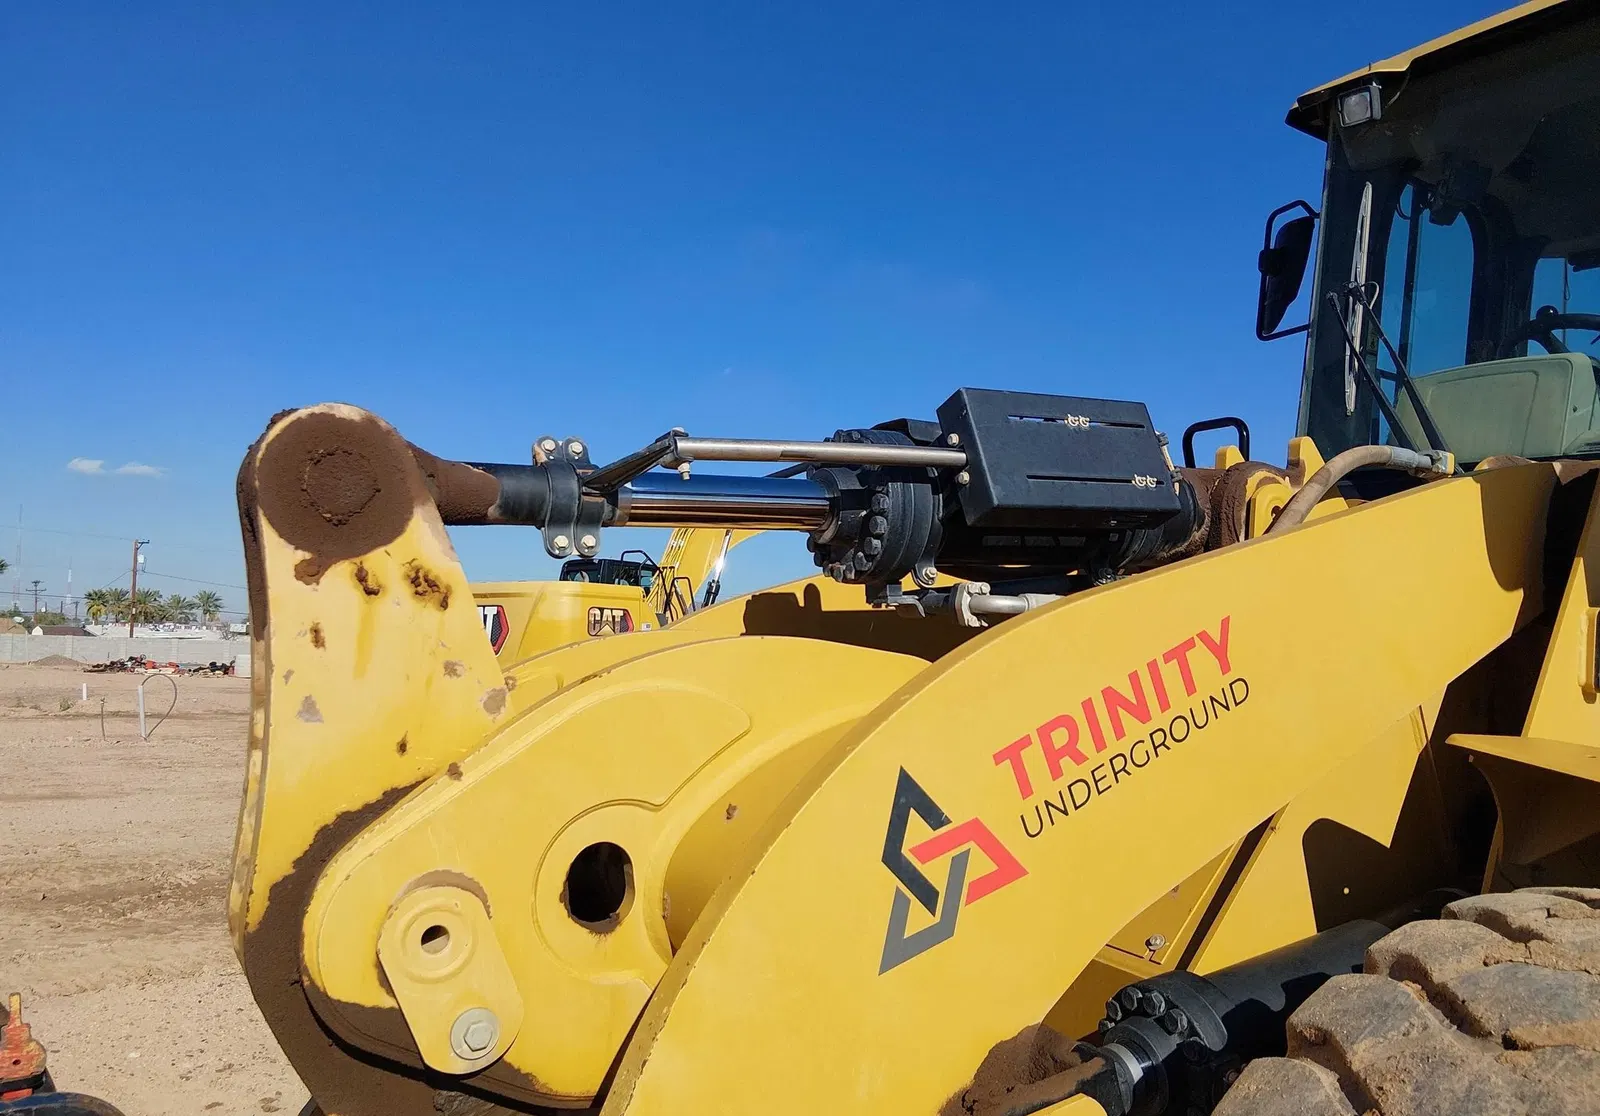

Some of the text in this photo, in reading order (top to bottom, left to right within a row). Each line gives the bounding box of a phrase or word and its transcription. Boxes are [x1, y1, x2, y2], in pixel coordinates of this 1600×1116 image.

[589, 608, 624, 635] CAT
[992, 615, 1231, 800] TRINITY
[1019, 677, 1250, 839] UNDERGROUND
